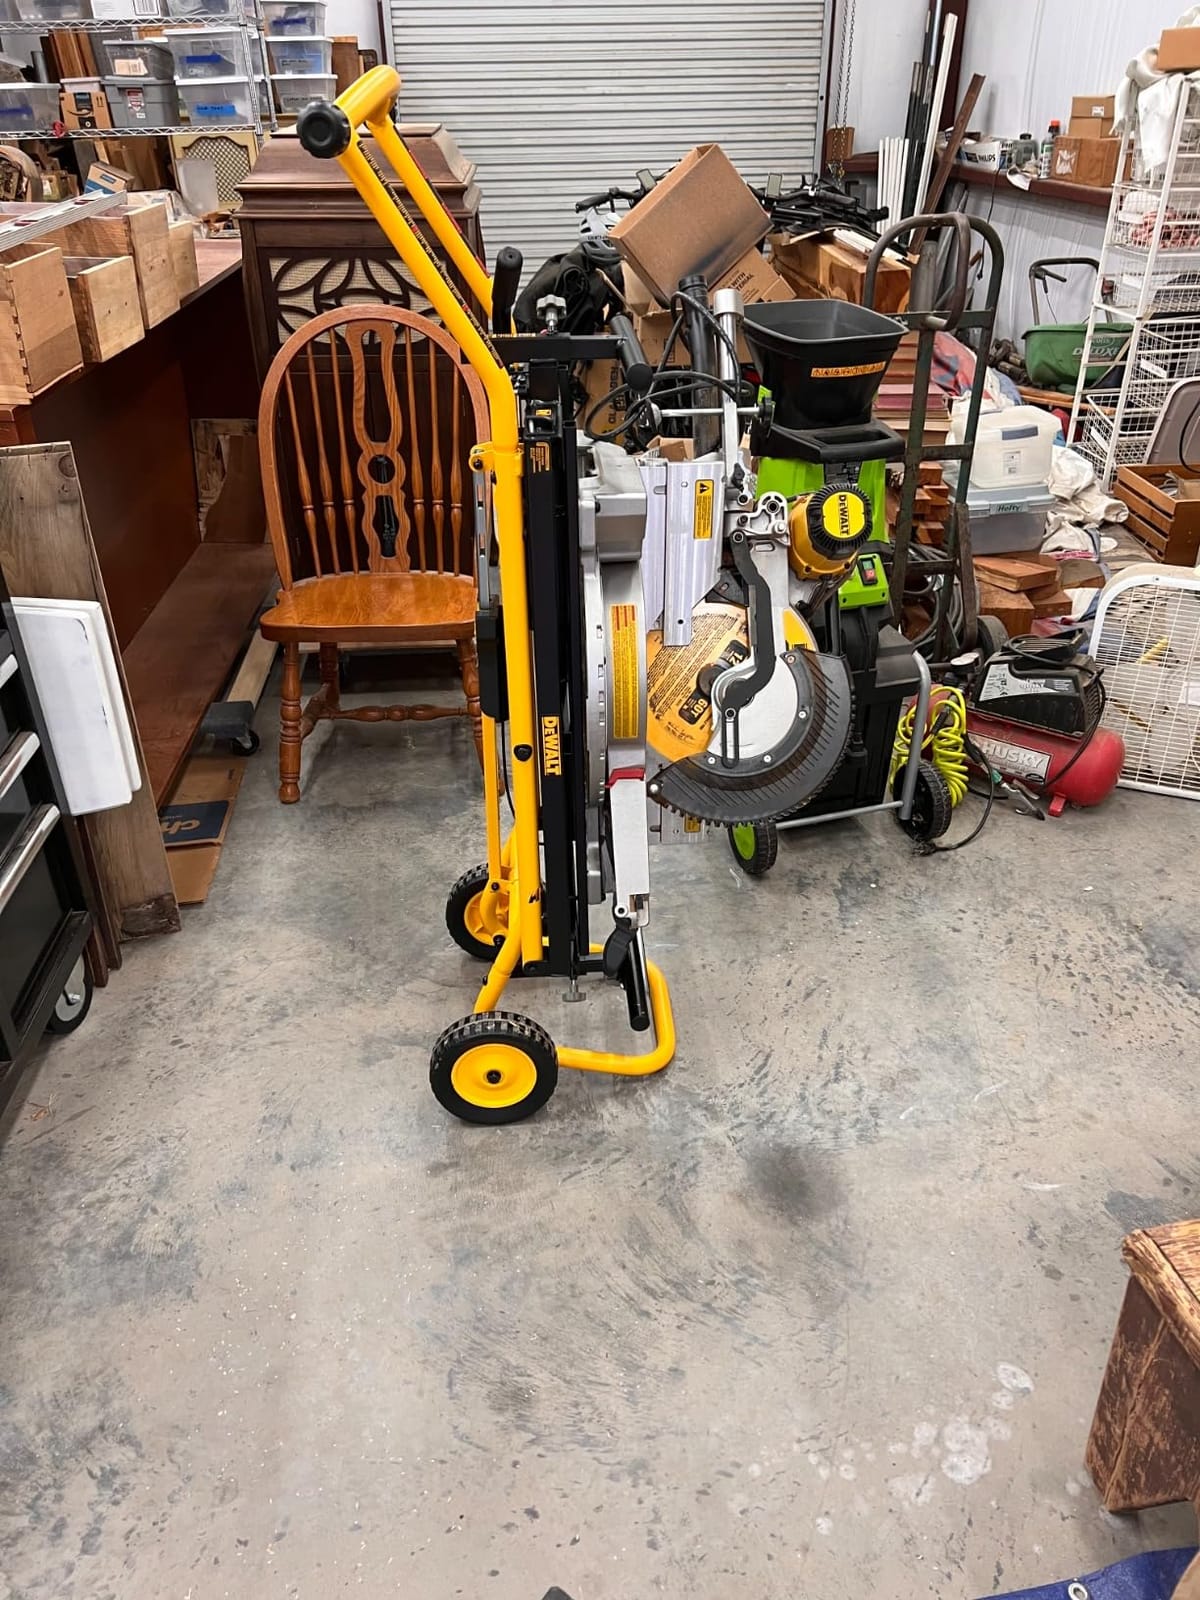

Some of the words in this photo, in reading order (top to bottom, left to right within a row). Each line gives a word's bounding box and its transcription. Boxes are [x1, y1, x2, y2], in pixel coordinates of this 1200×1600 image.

[736, 273, 755, 291] TERIAL
[690, 698, 709, 718] 60T
[982, 741, 1047, 769] HUSKY
